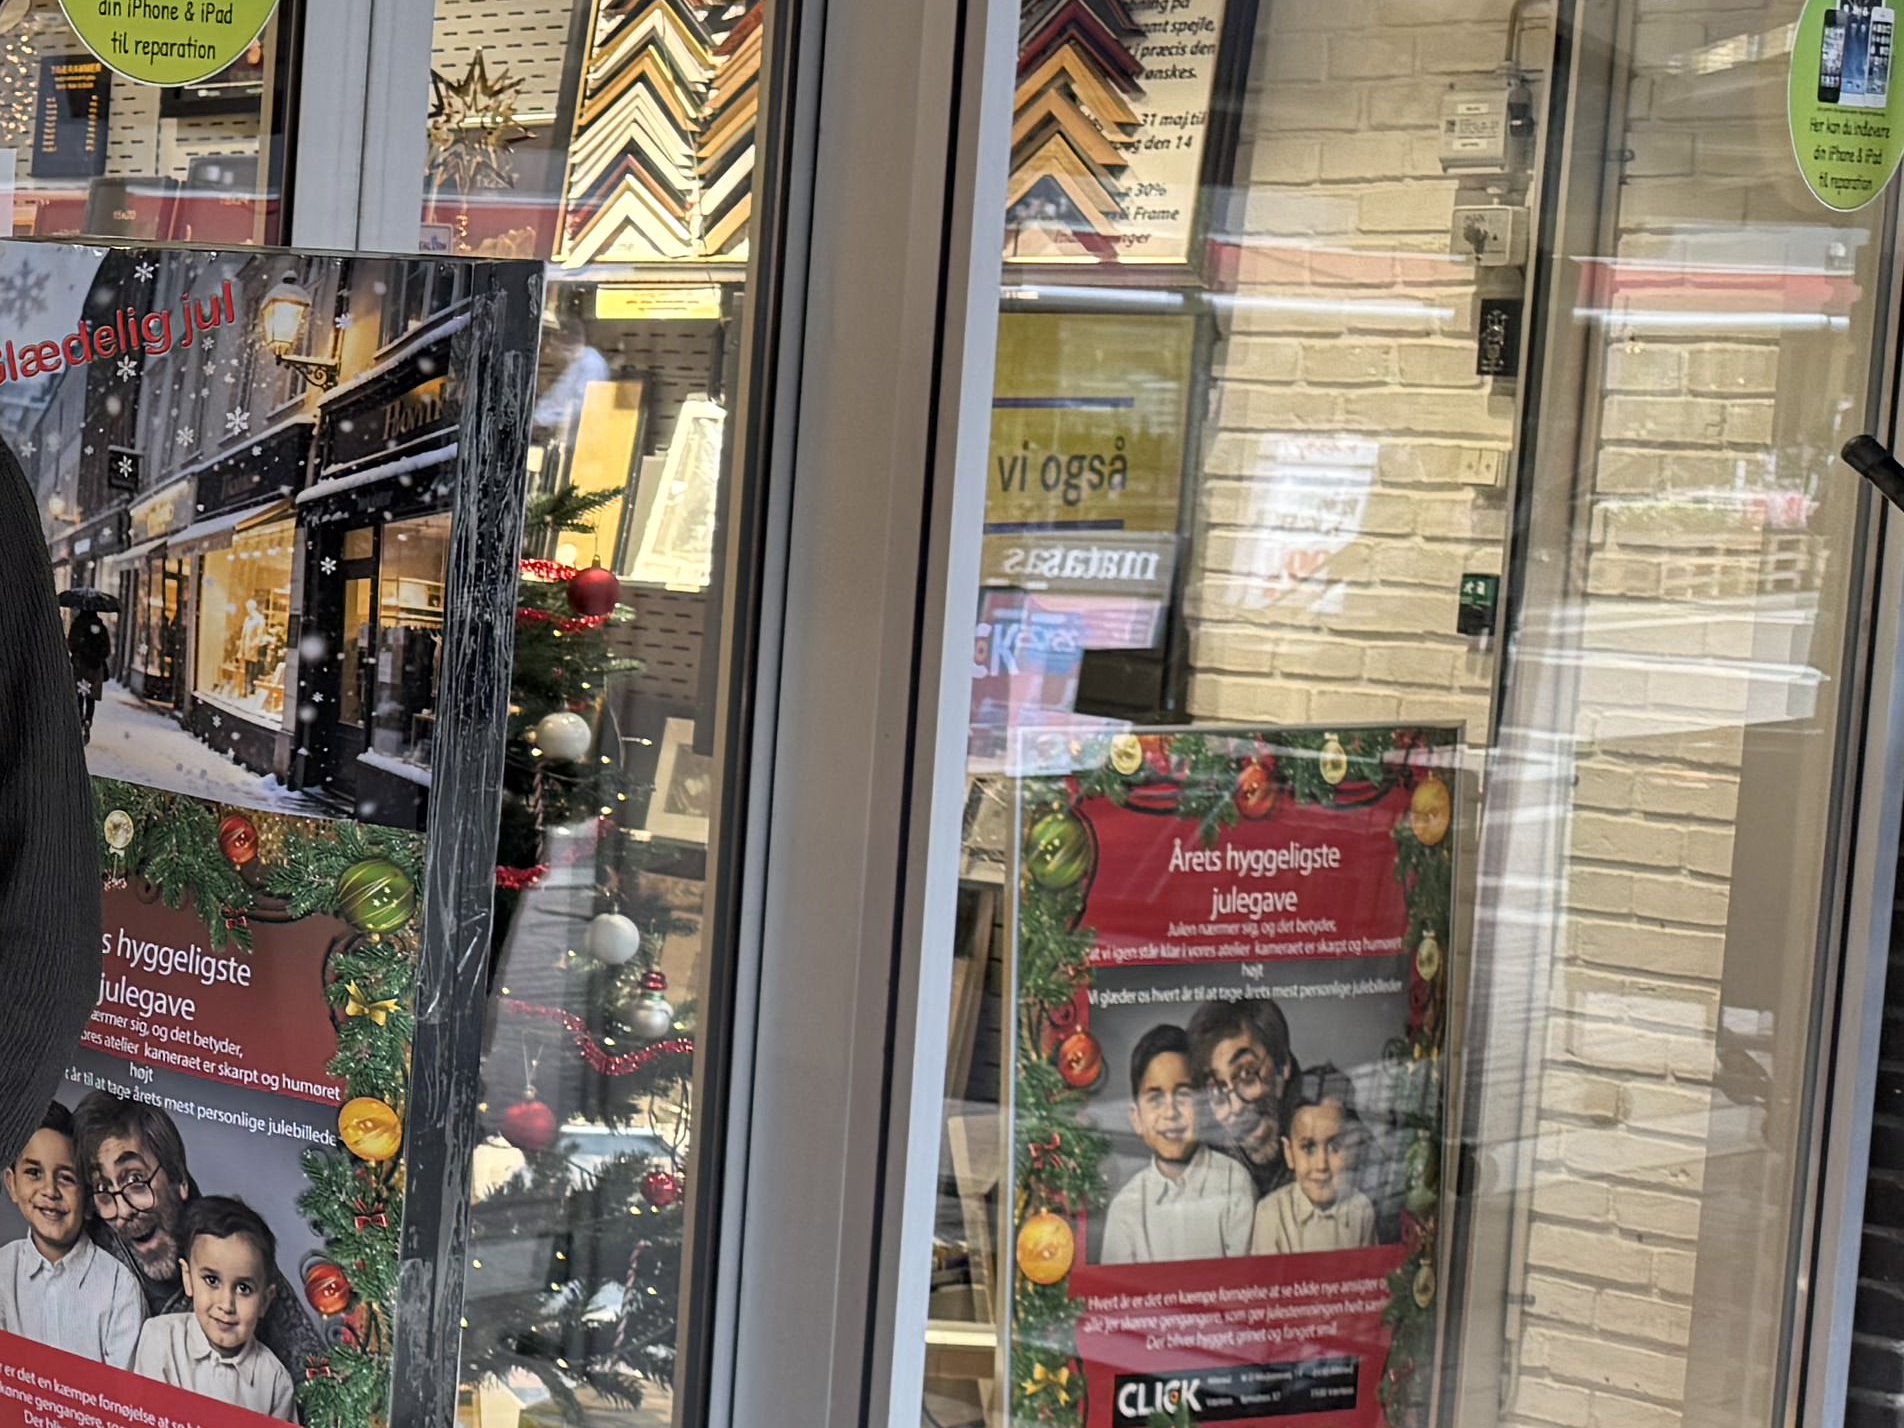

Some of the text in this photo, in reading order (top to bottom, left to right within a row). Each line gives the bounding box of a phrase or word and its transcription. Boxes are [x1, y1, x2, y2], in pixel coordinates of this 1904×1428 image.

[184, 1, 195, 22] &
[201, 2, 233, 25] iPad
[111, 35, 216, 66] til reparation
[180, 280, 236, 348] jul
[998, 435, 1128, 507] vi også
[1168, 837, 1342, 878] Årets hyggeligste
[1210, 885, 1298, 921] julegave
[117, 928, 252, 986] hyggeligste
[96, 972, 196, 1021] julegave
[90, 1010, 244, 1058] ærmer sig, og det betyder,
[104, 1035, 341, 1102] atelier kameraet er skarpt og humøret
[129, 1061, 154, 1083] højt
[108, 1078, 337, 1147] tage årets mest personlige julebillede
[23, 1408, 43, 1427] Der
[53, 1377, 98, 1407] kæmpe
[99, 1392, 157, 1426] fornøjelse
[1117, 1377, 1203, 1419] CLICK
